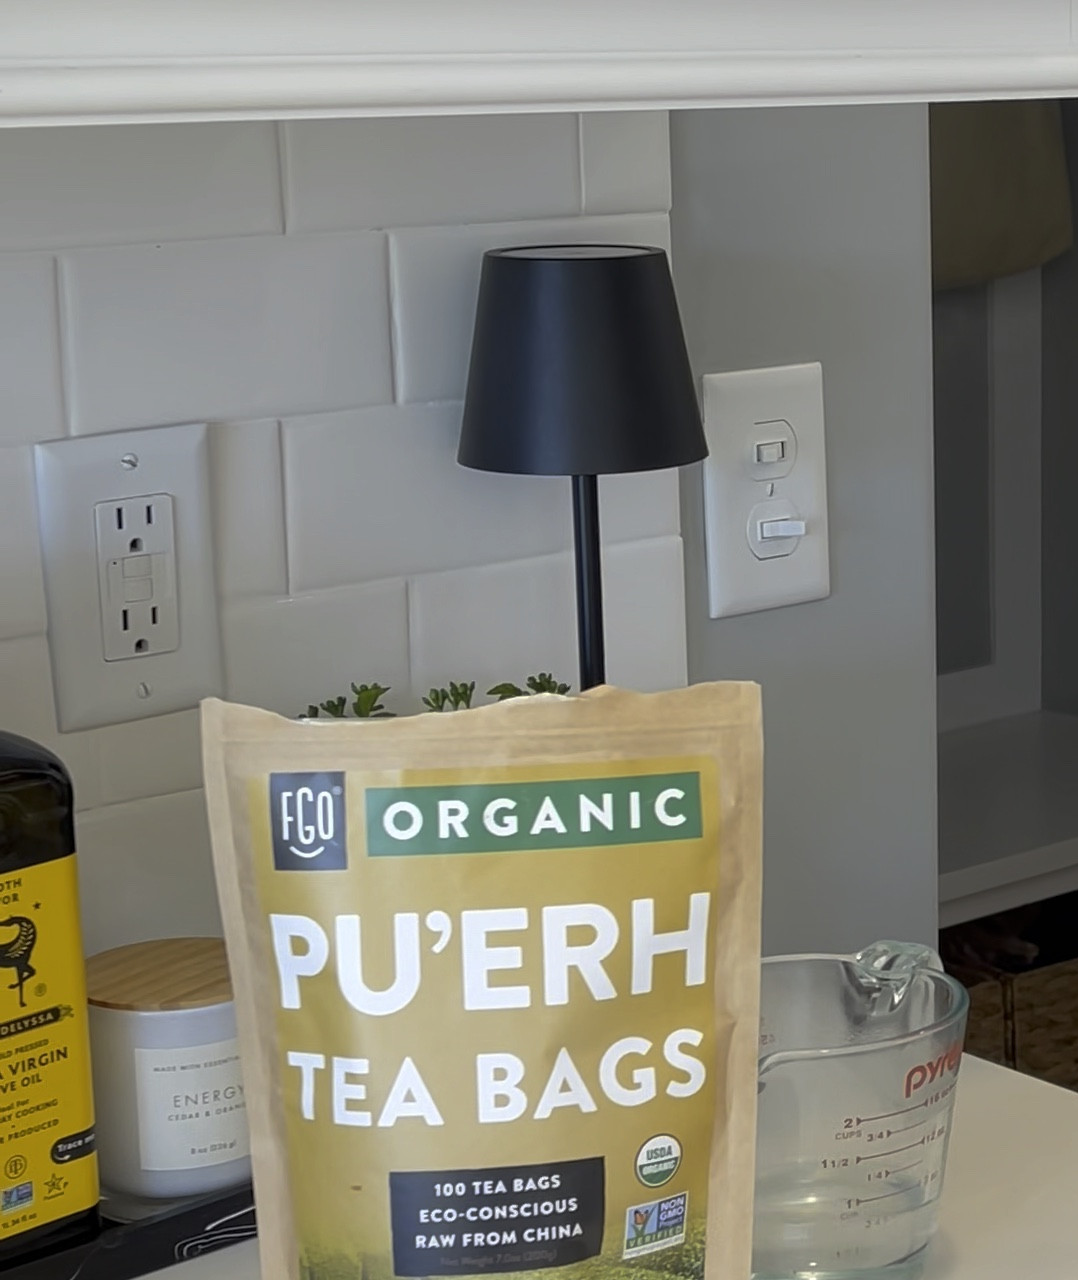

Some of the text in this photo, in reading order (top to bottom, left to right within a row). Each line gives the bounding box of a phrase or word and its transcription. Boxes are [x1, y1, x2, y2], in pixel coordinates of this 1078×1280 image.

[281, 786, 334, 844] FGO
[382, 787, 687, 840] ORGANIC
[8, 1046, 68, 1075] VIRGIN
[20, 1073, 42, 1087] OIL
[287, 1028, 707, 1128] TEA BAGS
[15, 1098, 59, 1118] COOKING
[8, 1118, 59, 1140] PRODUCED
[843, 1118, 854, 1129] 2
[835, 1130, 862, 1140] CUPS
[646, 1145, 673, 1161] USDA
[434, 1174, 561, 1197] 100 TEA BAGS
[419, 1197, 578, 1223] ECO-CONSCIOUS
[660, 1206, 684, 1221] GMO
[661, 1196, 684, 1211] NON
[415, 1223, 583, 1249] RAW FROM CHINA
[629, 1226, 683, 1248] VERIFIED
